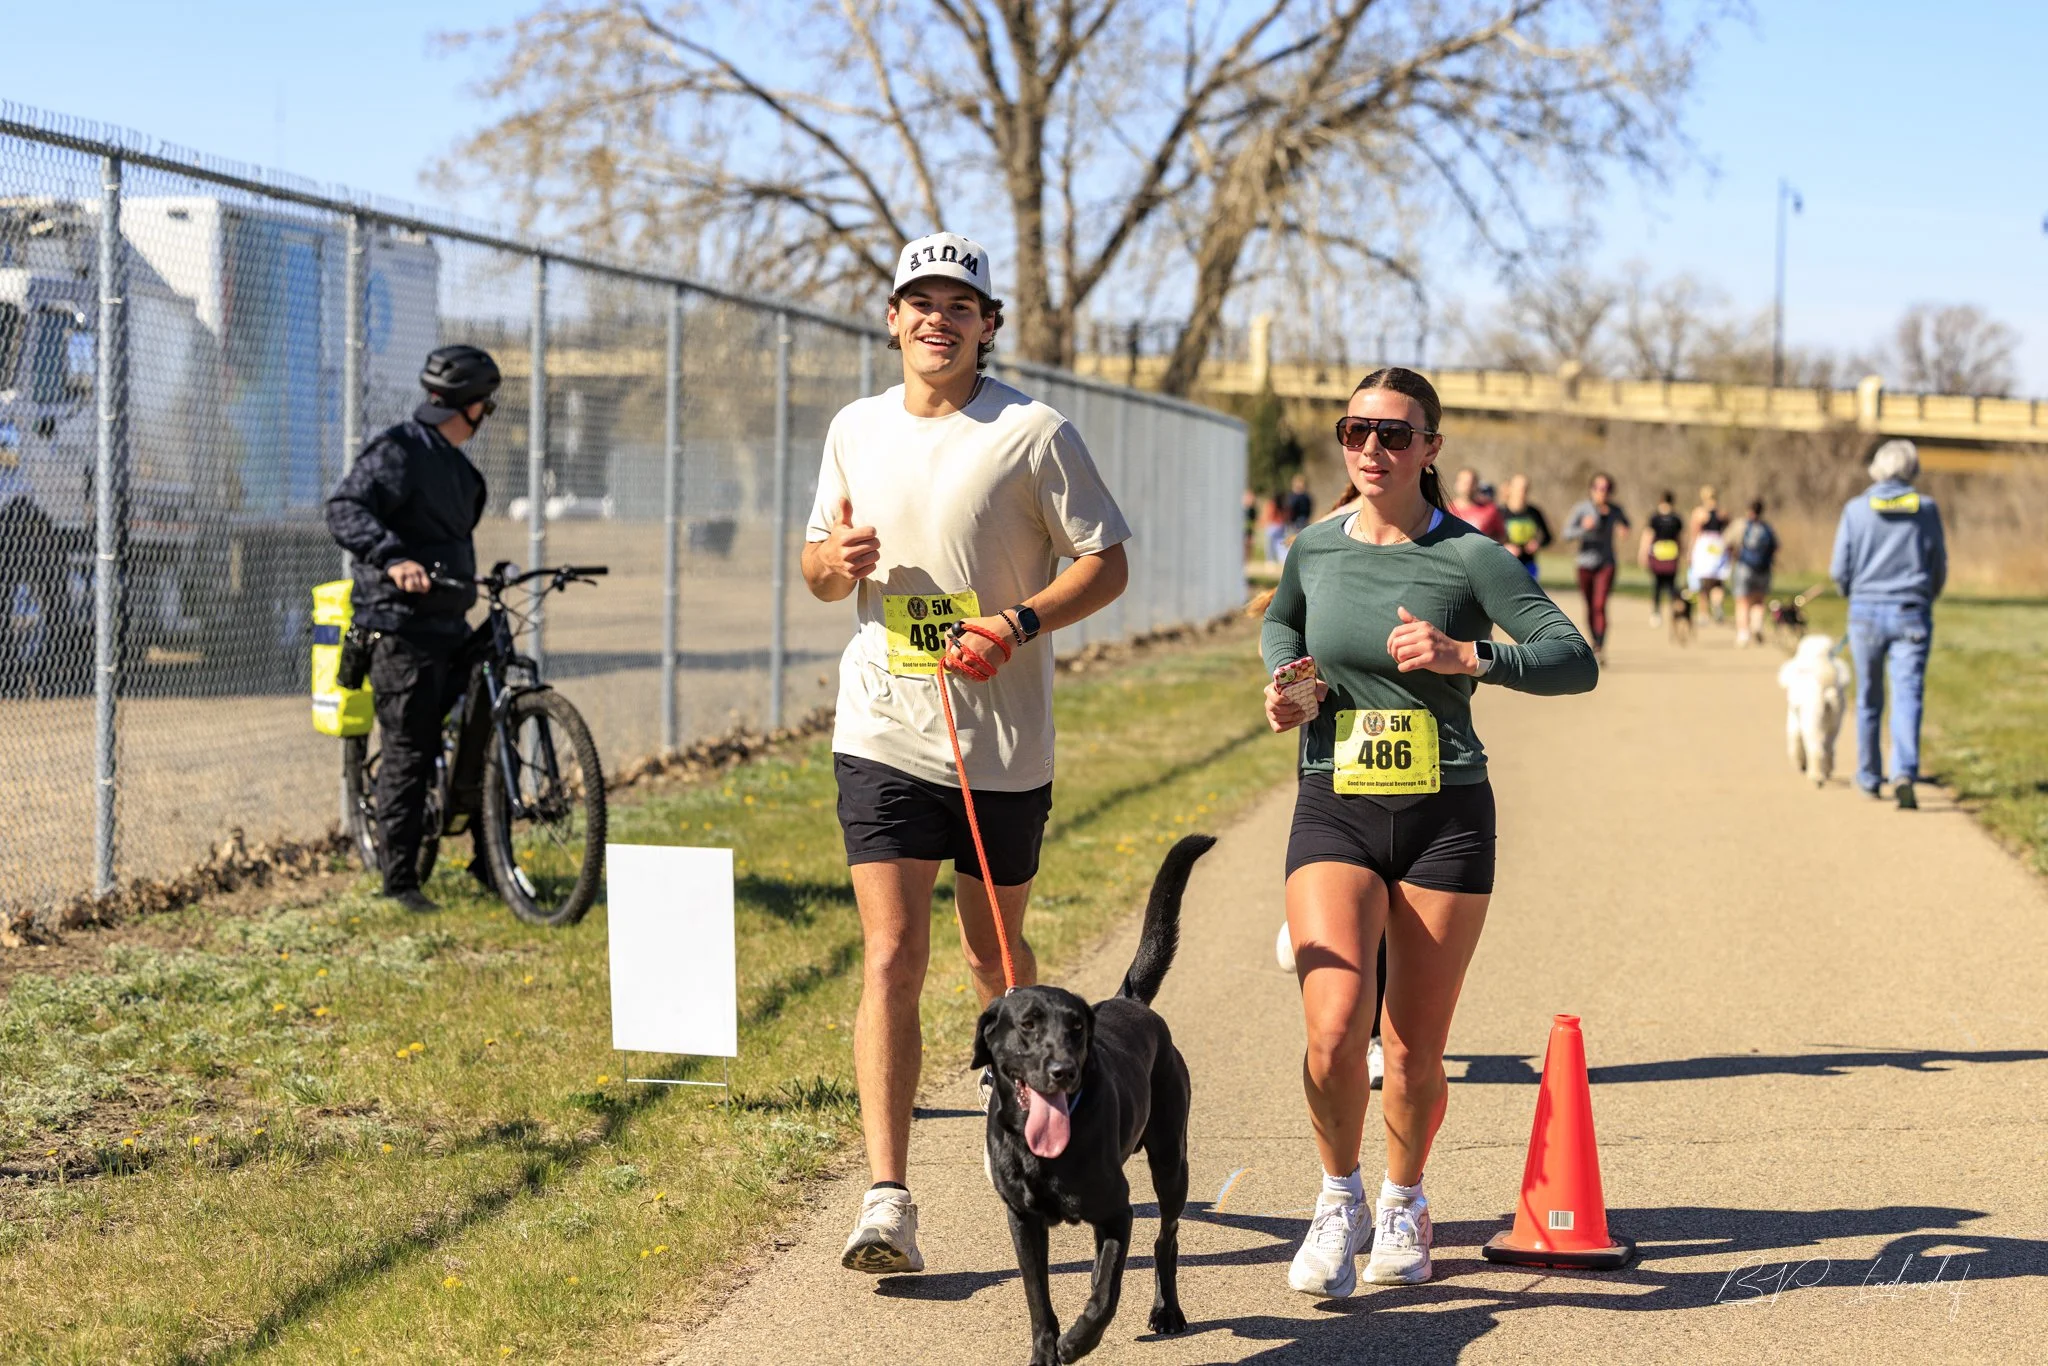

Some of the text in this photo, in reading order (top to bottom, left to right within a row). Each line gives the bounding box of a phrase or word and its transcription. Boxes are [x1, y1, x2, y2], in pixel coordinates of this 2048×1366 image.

[910, 244, 979, 276] WULF
[932, 599, 953, 616] 5K
[1390, 715, 1412, 732] 5K
[1357, 740, 1412, 770] 486
